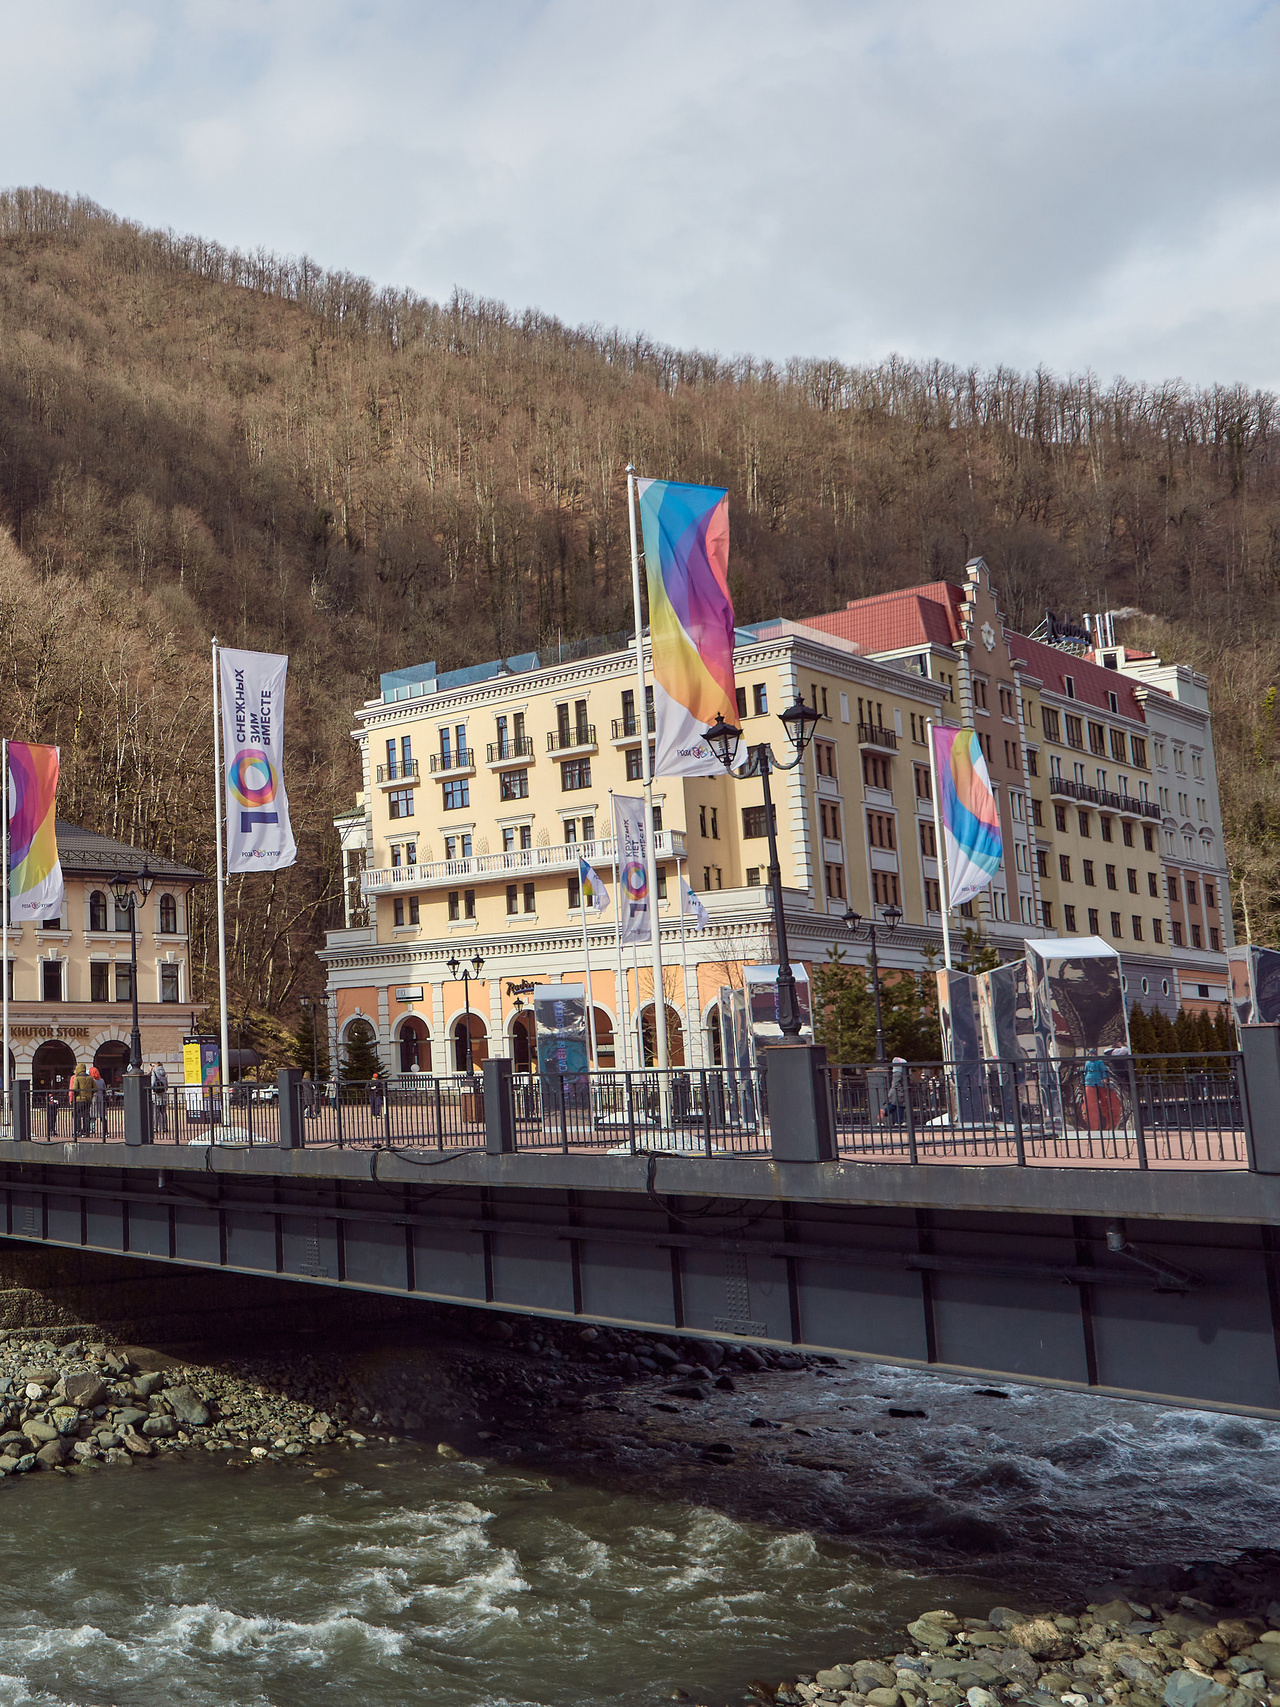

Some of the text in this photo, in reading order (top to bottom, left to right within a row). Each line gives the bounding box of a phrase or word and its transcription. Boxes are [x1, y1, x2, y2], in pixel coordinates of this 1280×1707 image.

[235, 669, 246, 743] СНЕЖНЫХ
[261, 690, 271, 746] ВМЕСТЕ
[250, 713, 261, 743] ЗИМ
[676, 749, 691, 757] РОЗА
[623, 819, 632, 858] КРУТЫХ
[10, 1027, 53, 1038] KHUTOR
[56, 1027, 90, 1038] STORE
